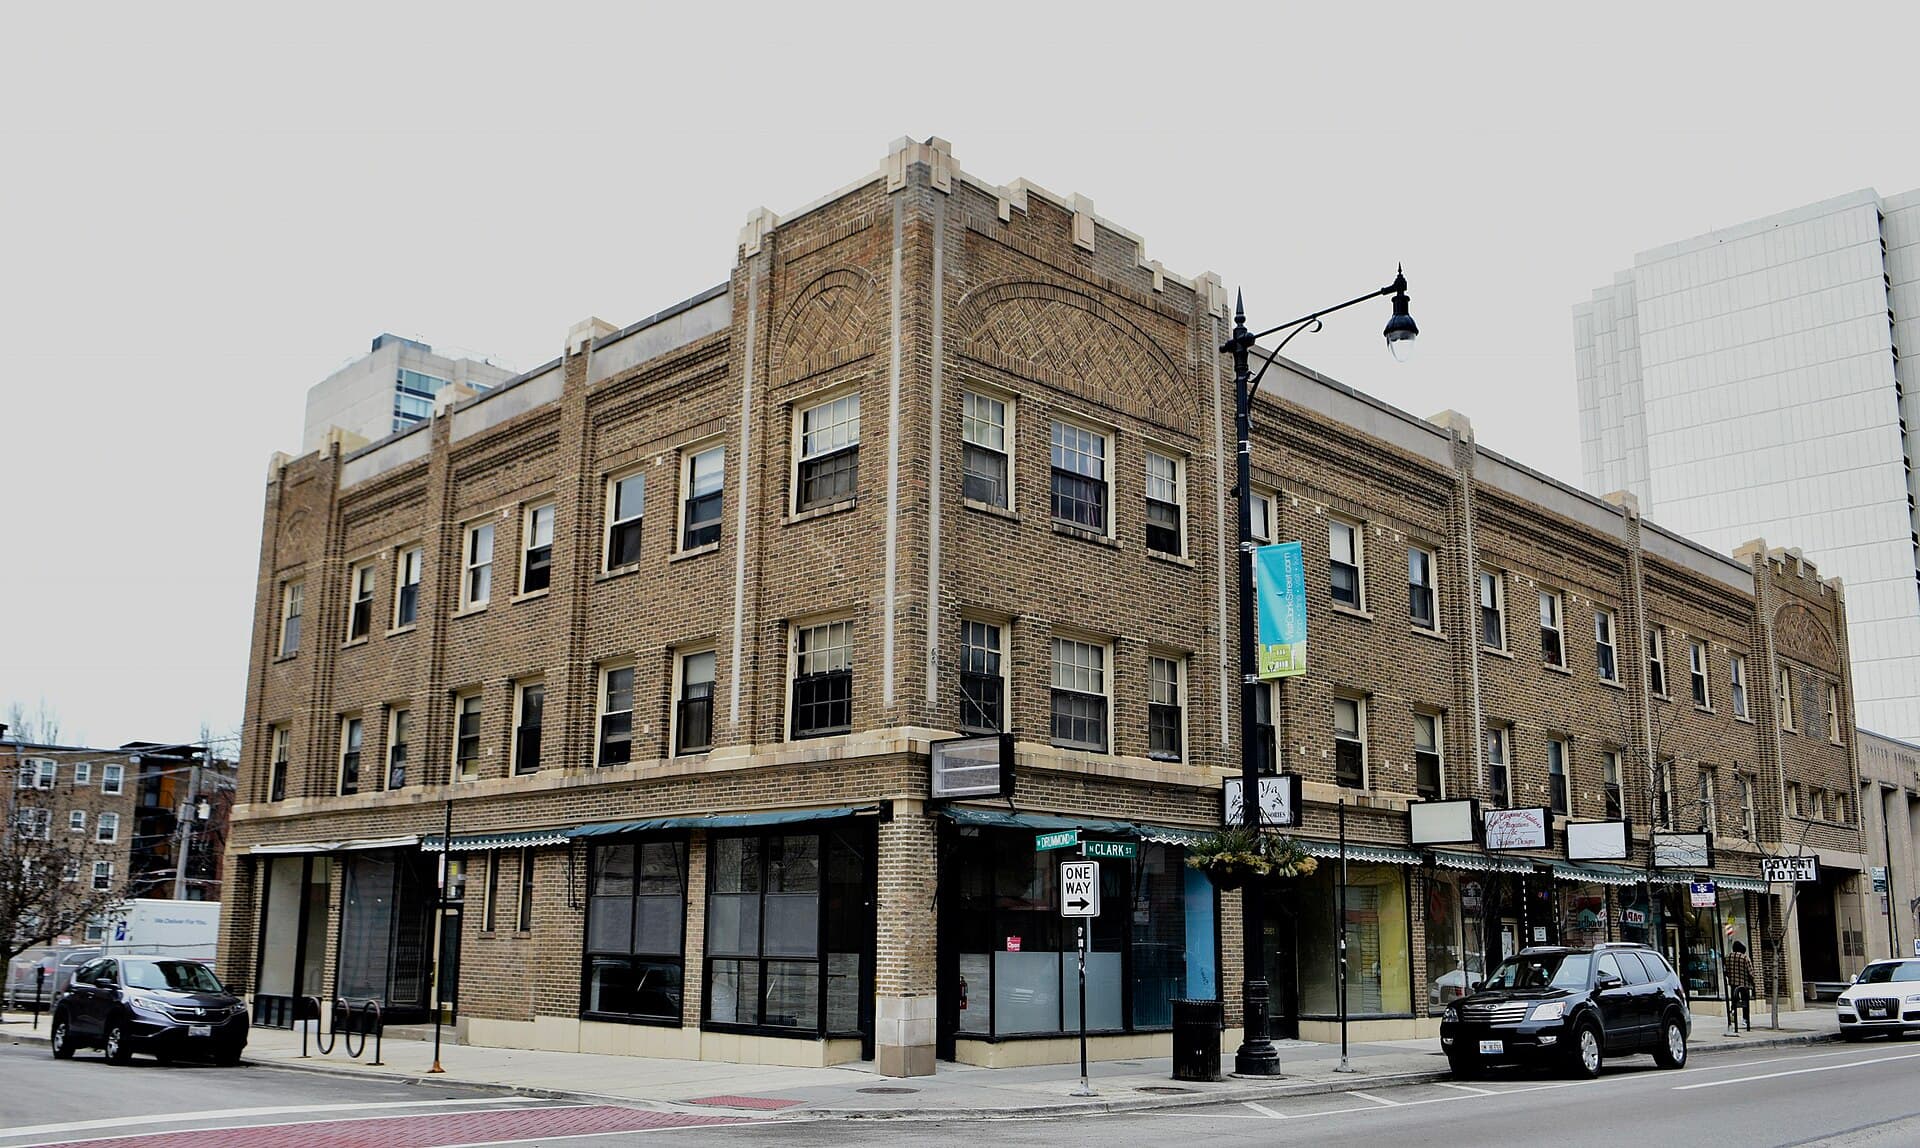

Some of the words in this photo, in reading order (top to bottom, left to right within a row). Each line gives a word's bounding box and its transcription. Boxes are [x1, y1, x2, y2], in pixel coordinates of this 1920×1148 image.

[1041, 833, 1070, 849] DRUMMOND
[1095, 844, 1124, 857] CLARK
[1764, 859, 1813, 870] COVENT
[1066, 867, 1091, 880] ONE
[1066, 882, 1091, 895] WAY
